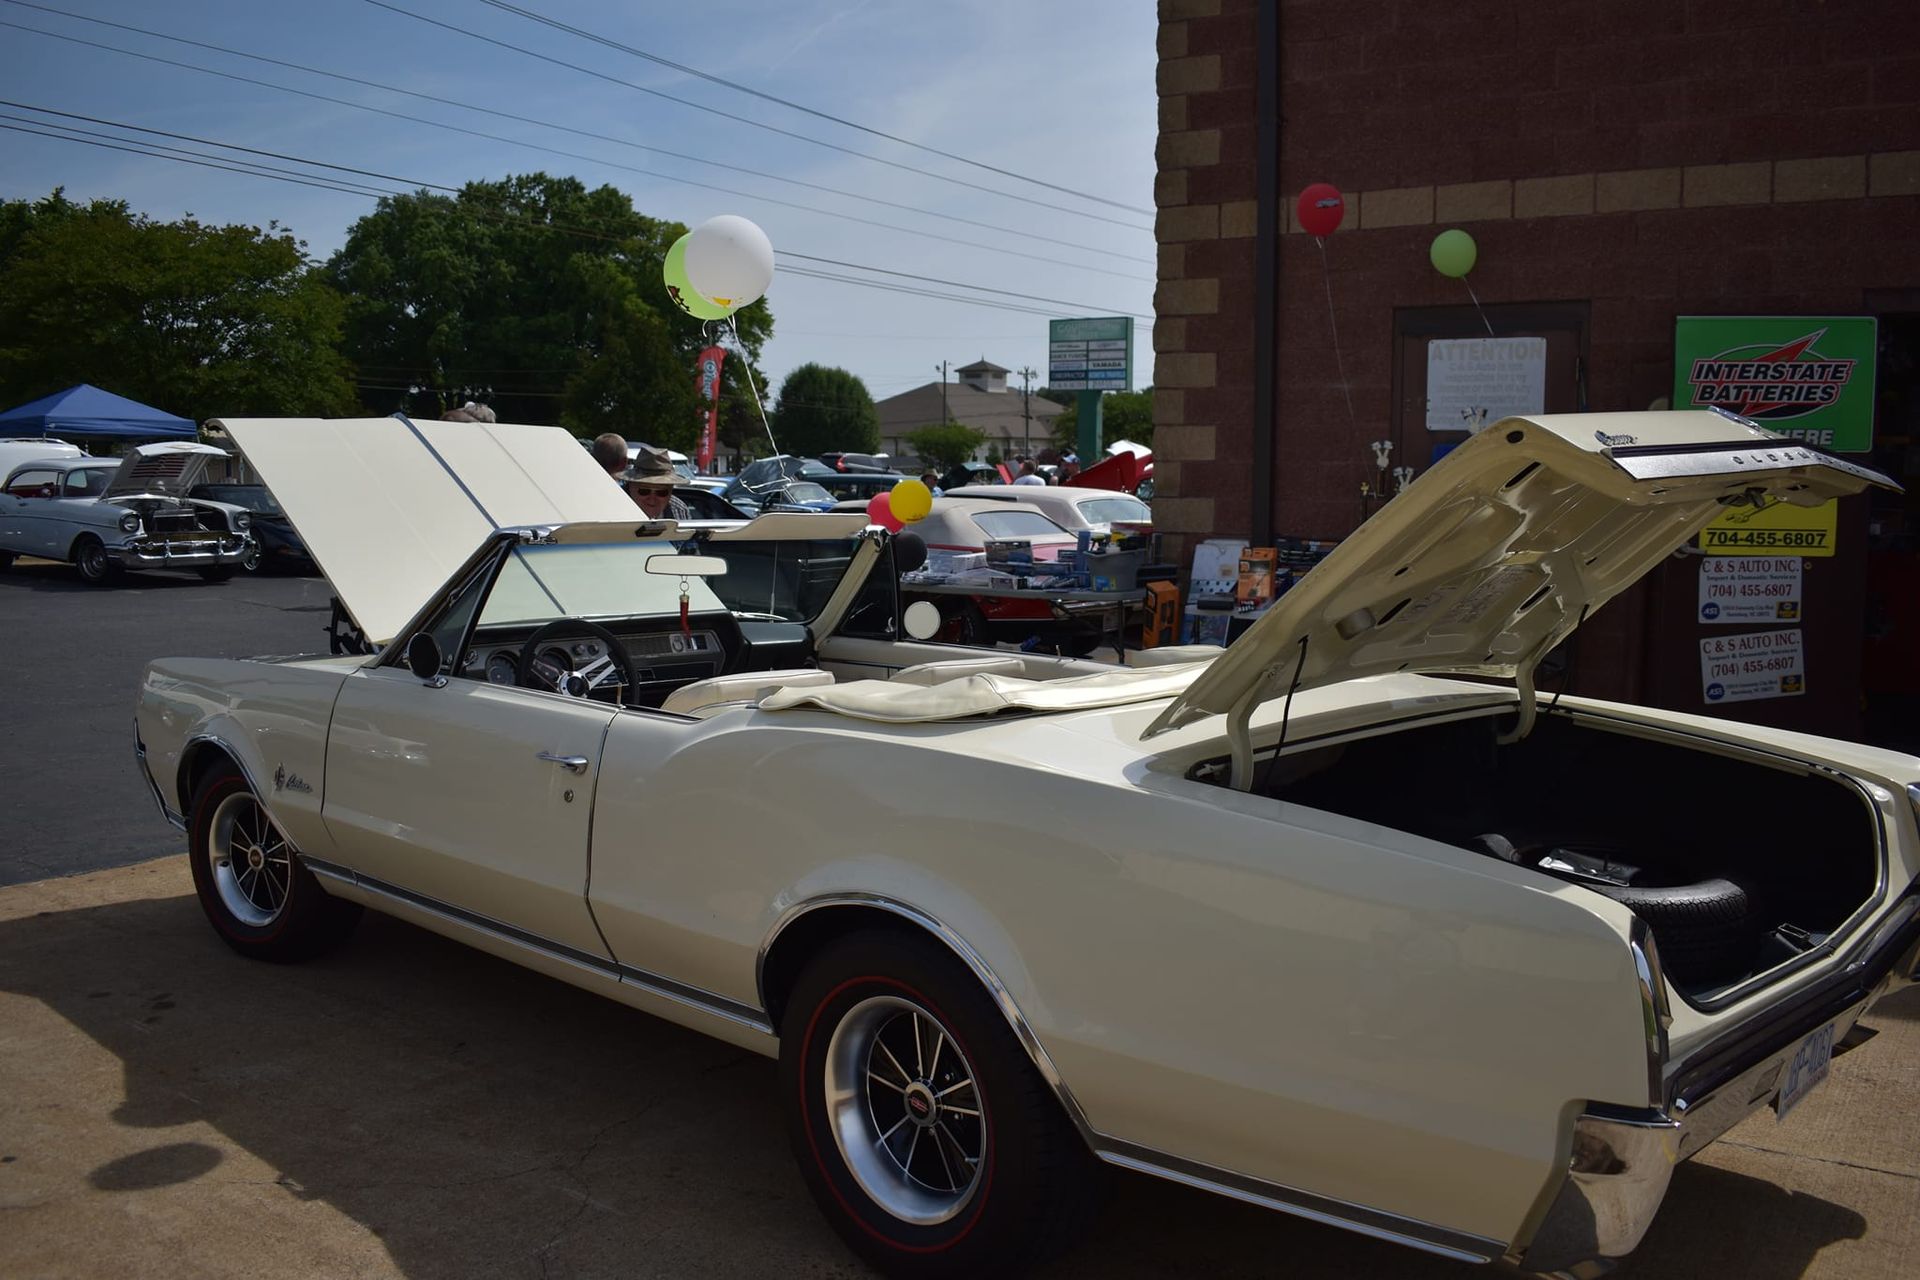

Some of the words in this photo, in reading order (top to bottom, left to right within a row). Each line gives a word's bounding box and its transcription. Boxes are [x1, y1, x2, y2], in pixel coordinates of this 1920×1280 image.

[1432, 342, 1543, 361] ATTENTION
[1695, 361, 1849, 380] INTERSTATE
[1699, 385, 1837, 402] BATTERIES
[1777, 429, 1835, 446] HERE
[1732, 450, 1860, 474] OLDSM
[1706, 531, 1827, 546] 704-455-6807
[1702, 560, 1711, 573] C
[1714, 560, 1724, 573] &
[1727, 560, 1735, 573] S
[1738, 560, 1771, 573] AUTO
[1775, 559, 1800, 573] INC.
[1708, 584, 1737, 598] (704)
[1740, 584, 1793, 597] 455-6807
[1703, 641, 1712, 654] C
[1715, 640, 1724, 653] &
[1728, 639, 1736, 652] S
[1739, 635, 1771, 650] AUTO
[1775, 632, 1801, 646] INC.
[1711, 663, 1740, 679] (704)
[1743, 657, 1795, 673] 455-6807
